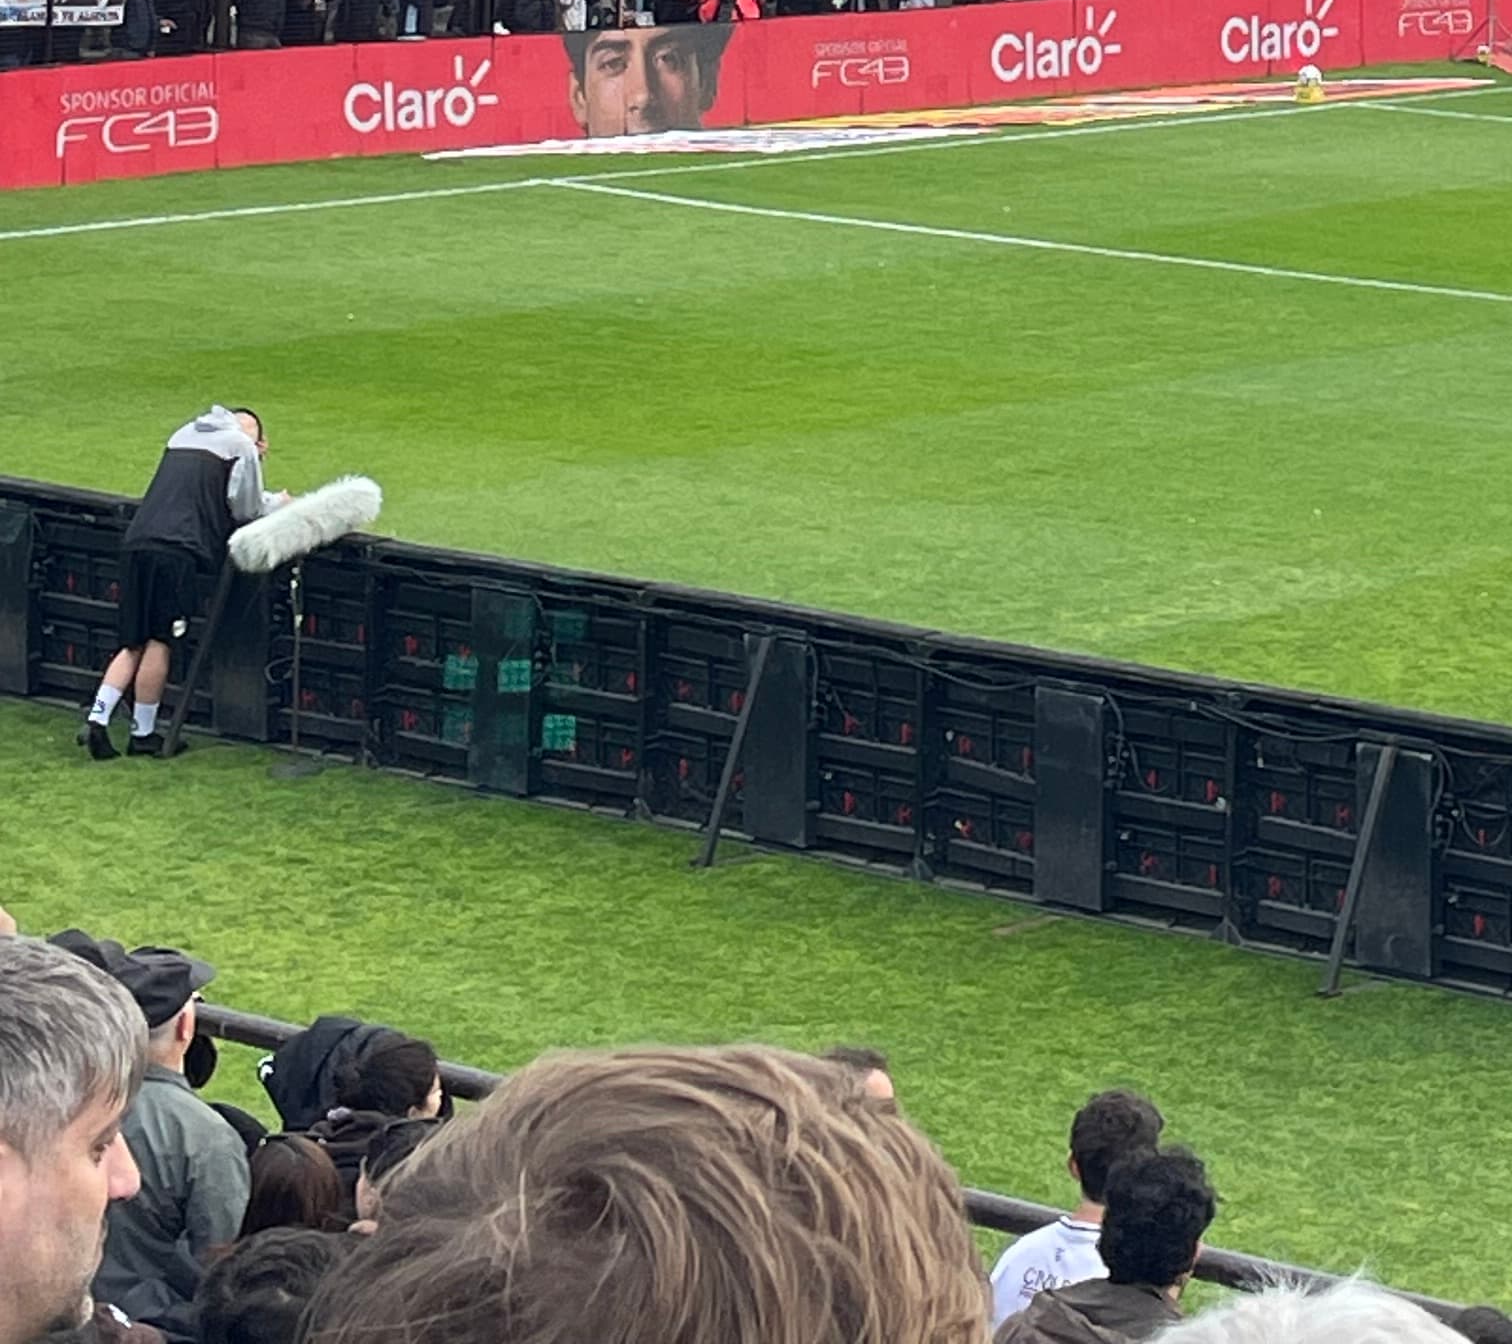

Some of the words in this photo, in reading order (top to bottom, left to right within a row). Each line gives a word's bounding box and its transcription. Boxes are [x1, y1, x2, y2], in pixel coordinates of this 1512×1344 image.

[1219, 15, 1323, 64] Claro
[1398, 9, 1474, 38] FC43
[811, 56, 910, 89] FC43
[990, 30, 1104, 83] Claro
[60, 87, 147, 114] SPONSOR
[150, 81, 218, 105] OFICIAL
[343, 79, 477, 134] Claro
[56, 105, 220, 159] FC43
